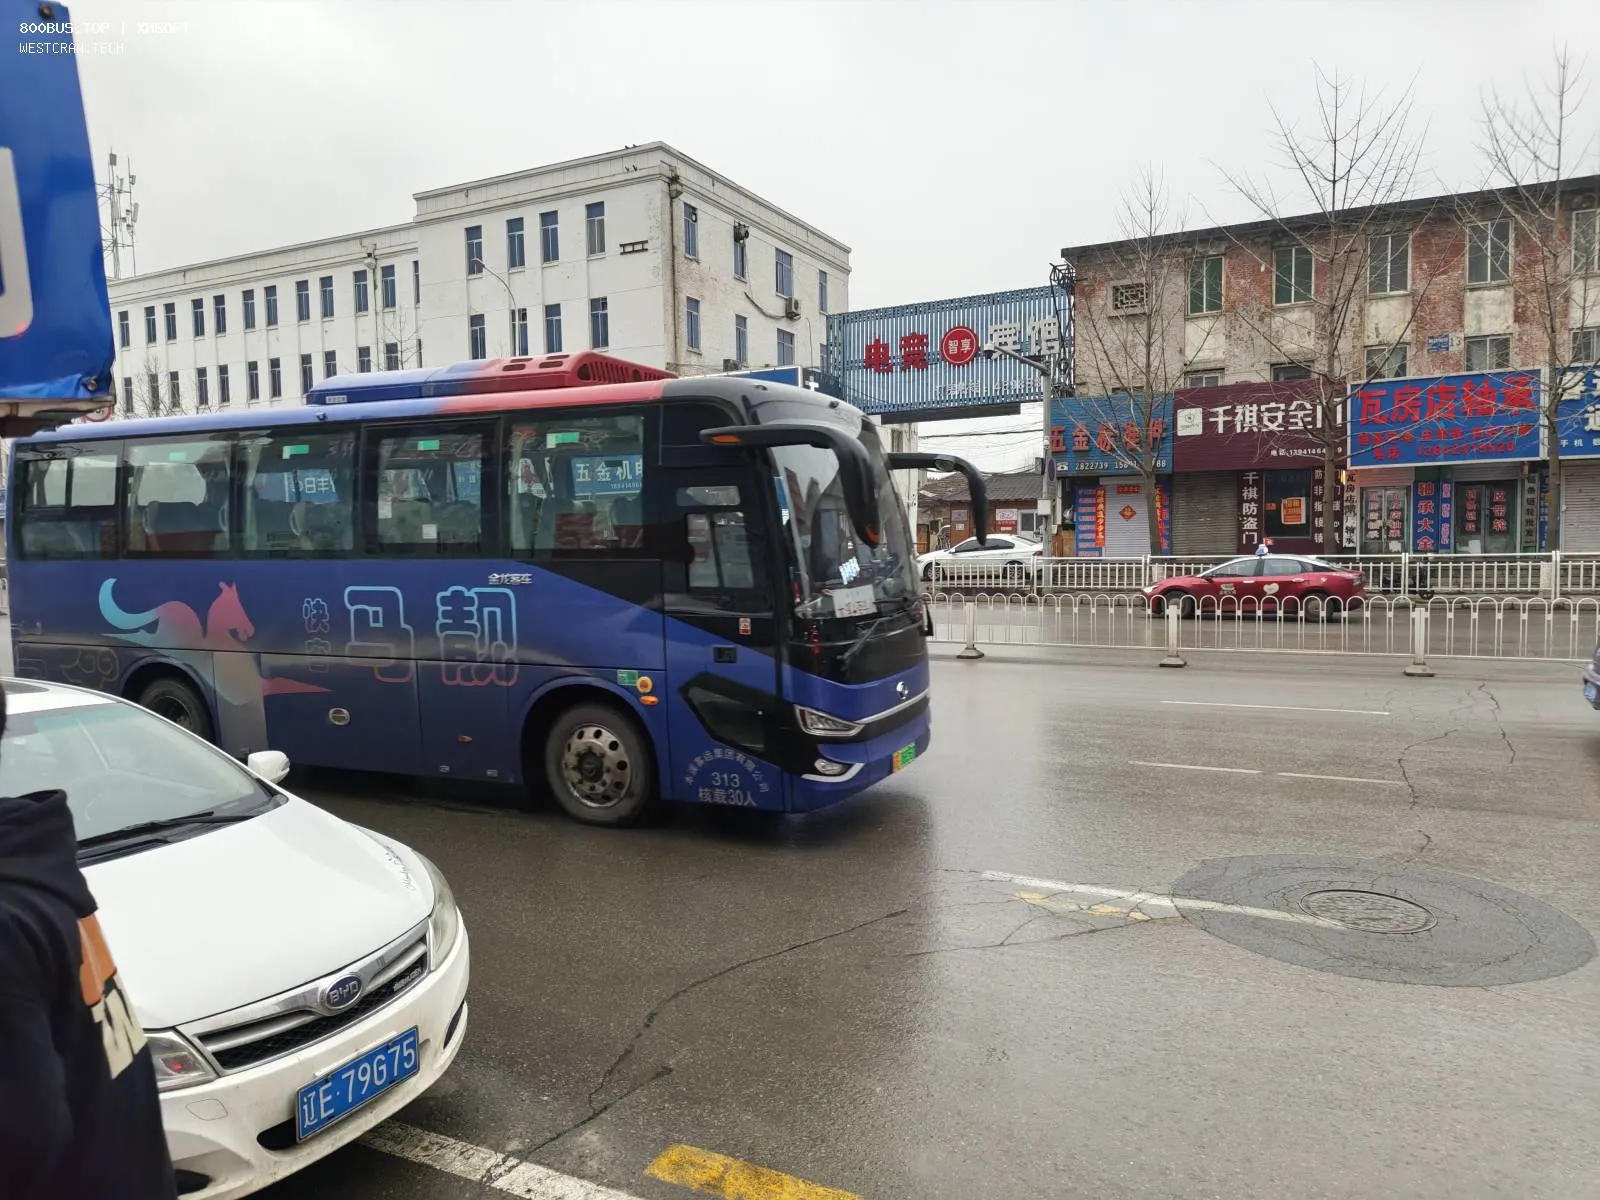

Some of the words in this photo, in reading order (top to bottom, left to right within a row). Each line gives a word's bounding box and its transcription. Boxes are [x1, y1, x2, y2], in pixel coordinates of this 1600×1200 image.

[865, 333, 929, 373] 电竞
[948, 338, 972, 354] 智享
[1208, 398, 1343, 435] 千祺安全门
[1357, 374, 1537, 426] 瓦房店轴承
[1242, 471, 1259, 545] 千祺防盗门
[1417, 482, 1435, 551] 轴承大全
[488, 573, 533, 585] 金龙客车
[698, 787, 758, 808] 核载30人
[711, 772, 740, 788] 313
[329, 980, 359, 1004] BYD
[303, 1035, 416, 1129] 辽E·79G75
